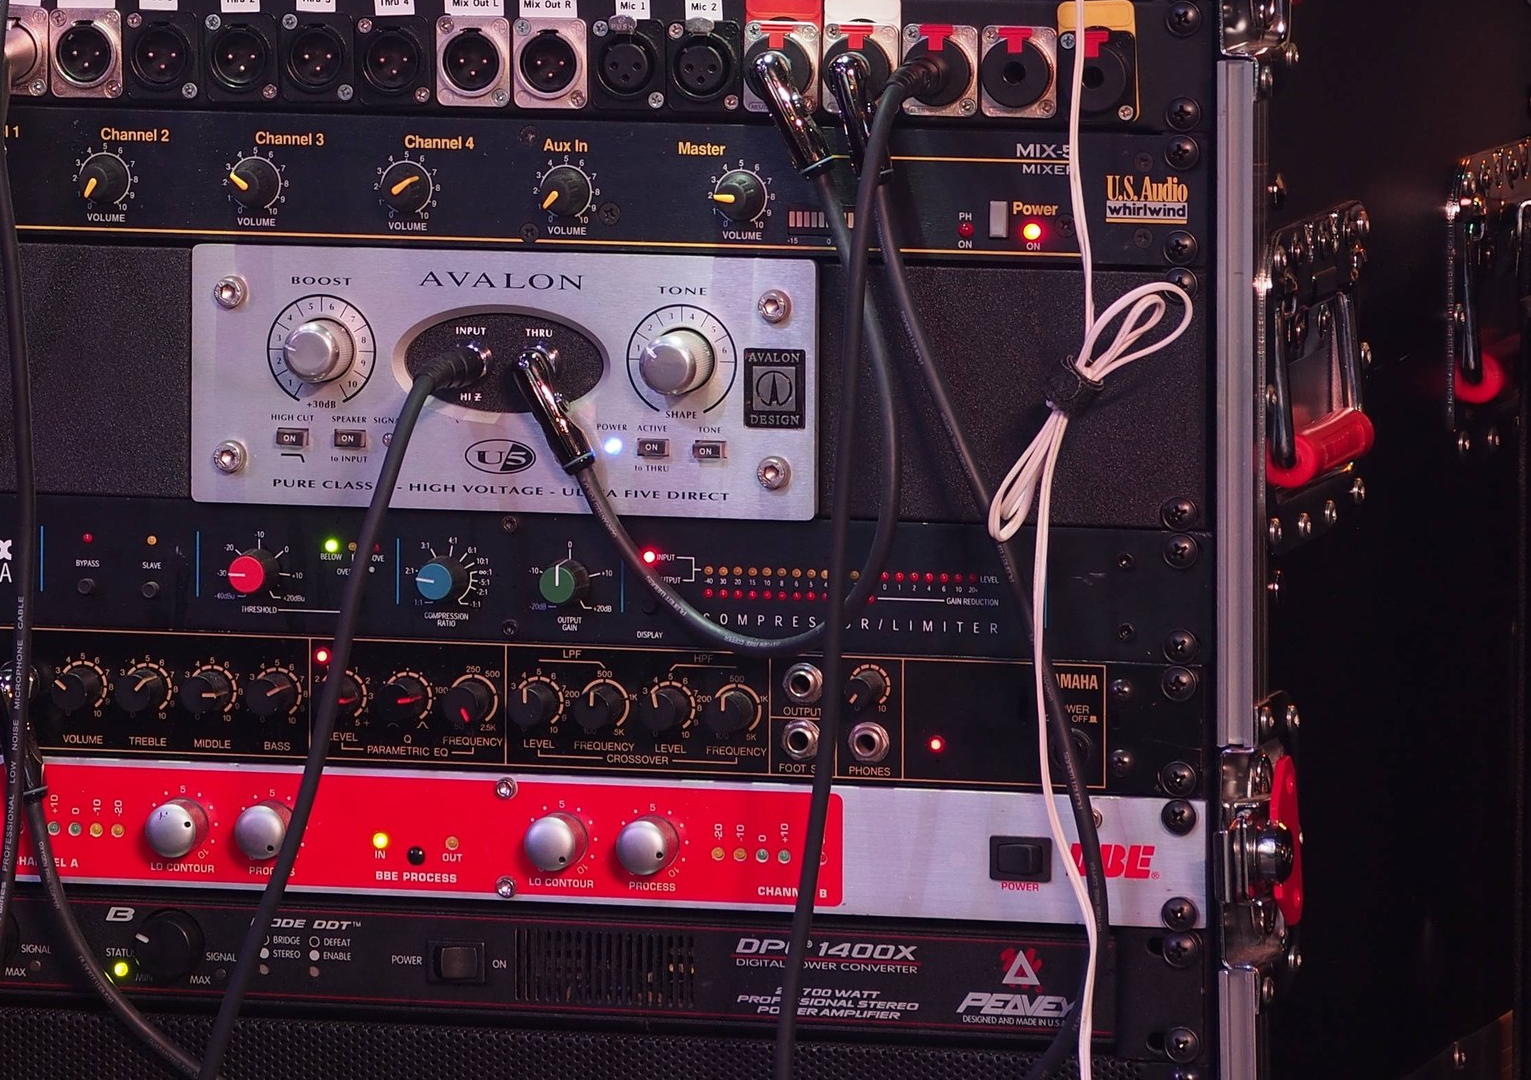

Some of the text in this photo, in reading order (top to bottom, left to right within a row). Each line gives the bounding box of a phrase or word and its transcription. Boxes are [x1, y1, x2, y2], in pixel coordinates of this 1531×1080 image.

[523, 0, 571, 9] Mix Out R
[620, 1, 645, 10] Mic 1
[691, 2, 717, 12] Mic 2
[101, 128, 169, 142] Channel 2
[255, 132, 324, 146] Channel 3
[404, 135, 474, 149] Channel 4
[544, 139, 588, 152] Aux In
[678, 142, 726, 156] Master
[1106, 176, 1188, 203] U.S. Audio
[1013, 202, 1058, 216] Power
[1108, 203, 1186, 217] whirlwind
[87, 213, 126, 222] VOLUME
[388, 222, 427, 231] VOLUME
[292, 276, 352, 286] BOOST
[419, 271, 583, 291] AVALON
[658, 286, 707, 295] TONE
[455, 326, 486, 335] INPUT
[525, 328, 553, 337] THRU
[748, 353, 800, 363] AVALON
[298, 414, 314, 422] CUT
[666, 411, 697, 419] SHAPE
[751, 415, 800, 425] DESIGN
[273, 479, 730, 501] PURE CLASS HIGH VOLTAGE FIVE DIRECT
[76, 560, 100, 568] BYPASS
[142, 561, 161, 569] SLAVE
[424, 612, 469, 620] COMPRESSION
[557, 616, 581, 624] OUTPUT
[437, 620, 456, 628] RATIO
[563, 650, 582, 658] LPF
[63, 734, 103, 744] VOLUME
[128, 736, 167, 746] TREBLE
[194, 739, 231, 749] MIDDLE
[264, 742, 291, 751] BASS
[367, 746, 448, 757] PARAMETRIC EQ
[607, 755, 669, 764] CROSSOVER
[849, 766, 891, 776] PHONES
[151, 863, 215, 873] LO CONTOUR
[376, 871, 457, 883] BBE PROCESS
[1001, 882, 1039, 891] POWER
[106, 907, 135, 922] B
[273, 936, 300, 945] BRIDGE
[323, 938, 350, 947] DEFEAT
[323, 952, 351, 960] ENABLE
[818, 942, 918, 961] 1400X
[392, 955, 422, 965] POWER
[492, 959, 507, 969] ON
[840, 963, 917, 974] CONVERTER
[803, 988, 881, 999] 700 WATT
[859, 1000, 919, 1011] STEREO
[956, 992, 1076, 1017] PEAVEY
[823, 1008, 900, 1019] AMPLIFIER
